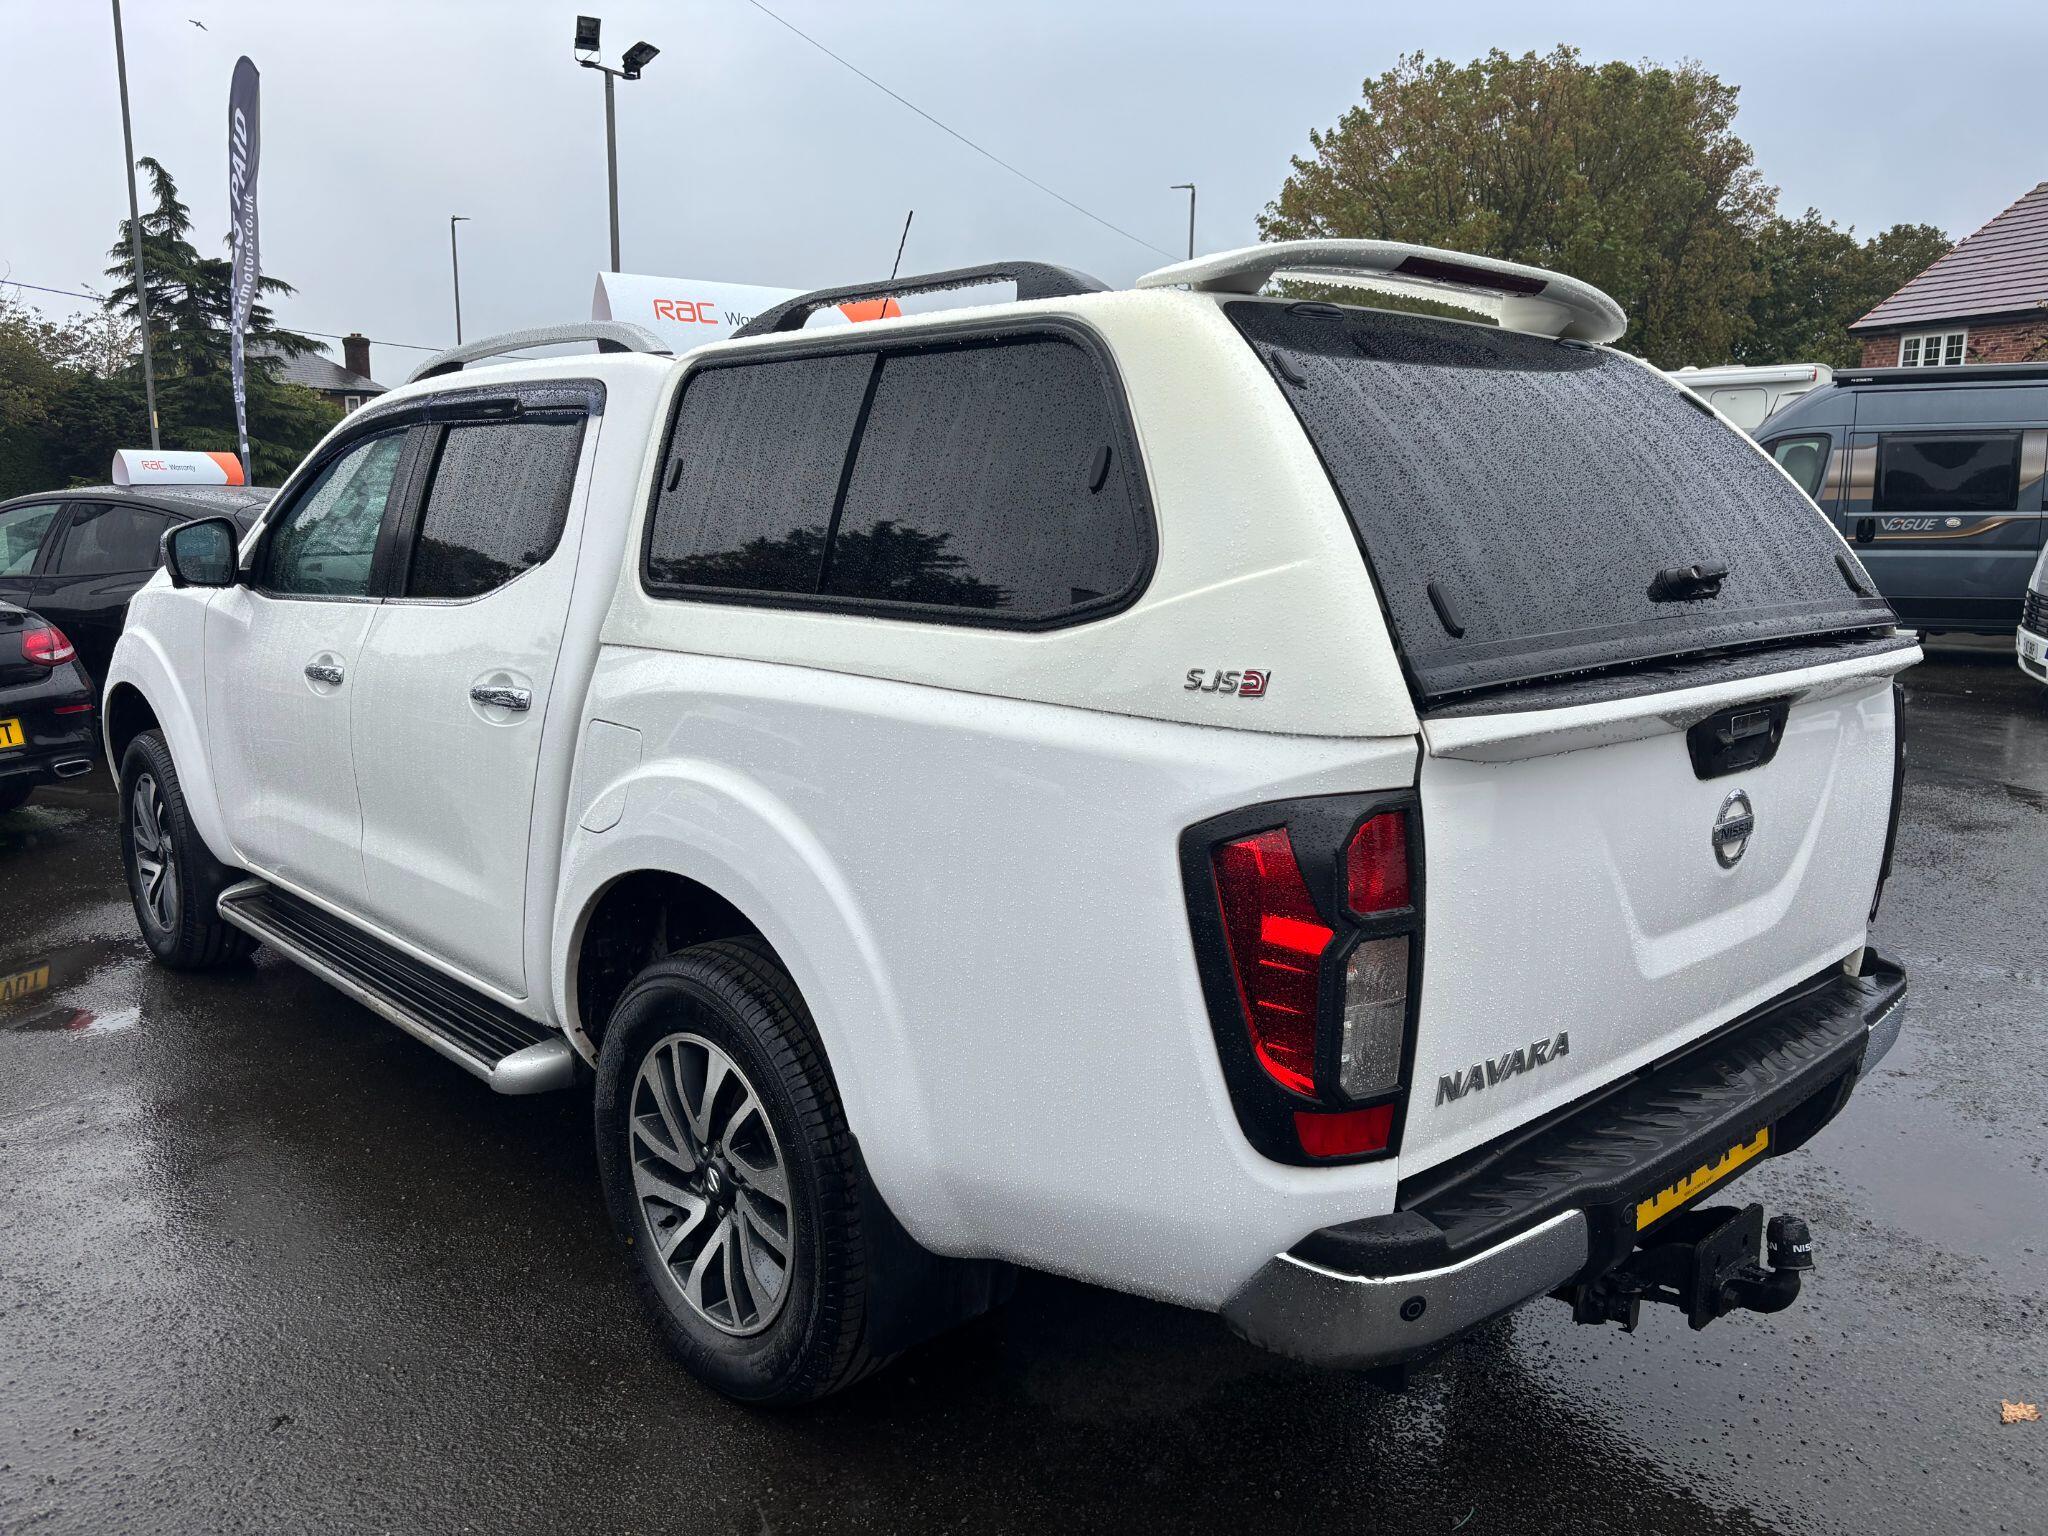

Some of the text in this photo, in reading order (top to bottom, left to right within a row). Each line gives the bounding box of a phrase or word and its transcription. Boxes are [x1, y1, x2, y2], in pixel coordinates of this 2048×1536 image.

[231, 107, 247, 210] PAID
[239, 193, 254, 317] etmotors.co.uk
[169, 464, 196, 472] Warranty
[1881, 518, 1939, 531] VOGUE
[1721, 820, 1754, 840] NISSAN
[1435, 1029, 1570, 1107] NAVARA
[1792, 1241, 1813, 1253] NIS
